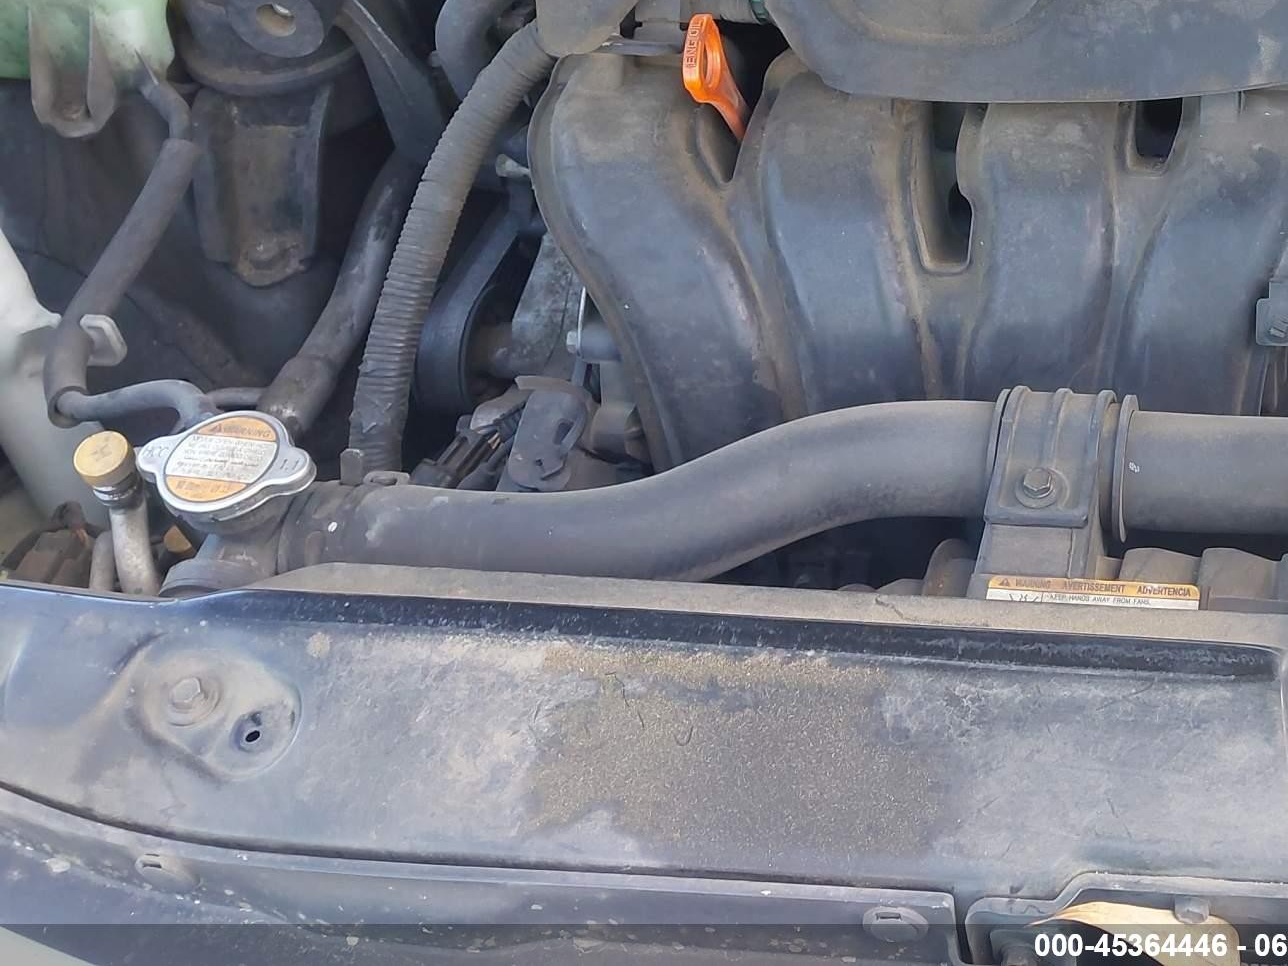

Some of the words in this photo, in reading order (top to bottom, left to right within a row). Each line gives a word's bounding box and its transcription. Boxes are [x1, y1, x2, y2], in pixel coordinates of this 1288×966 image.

[686, 39, 698, 68] ENG
[223, 423, 271, 437] WARNING
[1015, 578, 1051, 589] WARNING
[1064, 579, 1126, 593] AVERTISSEMENT
[1137, 585, 1191, 596] ADVERTENCIA
